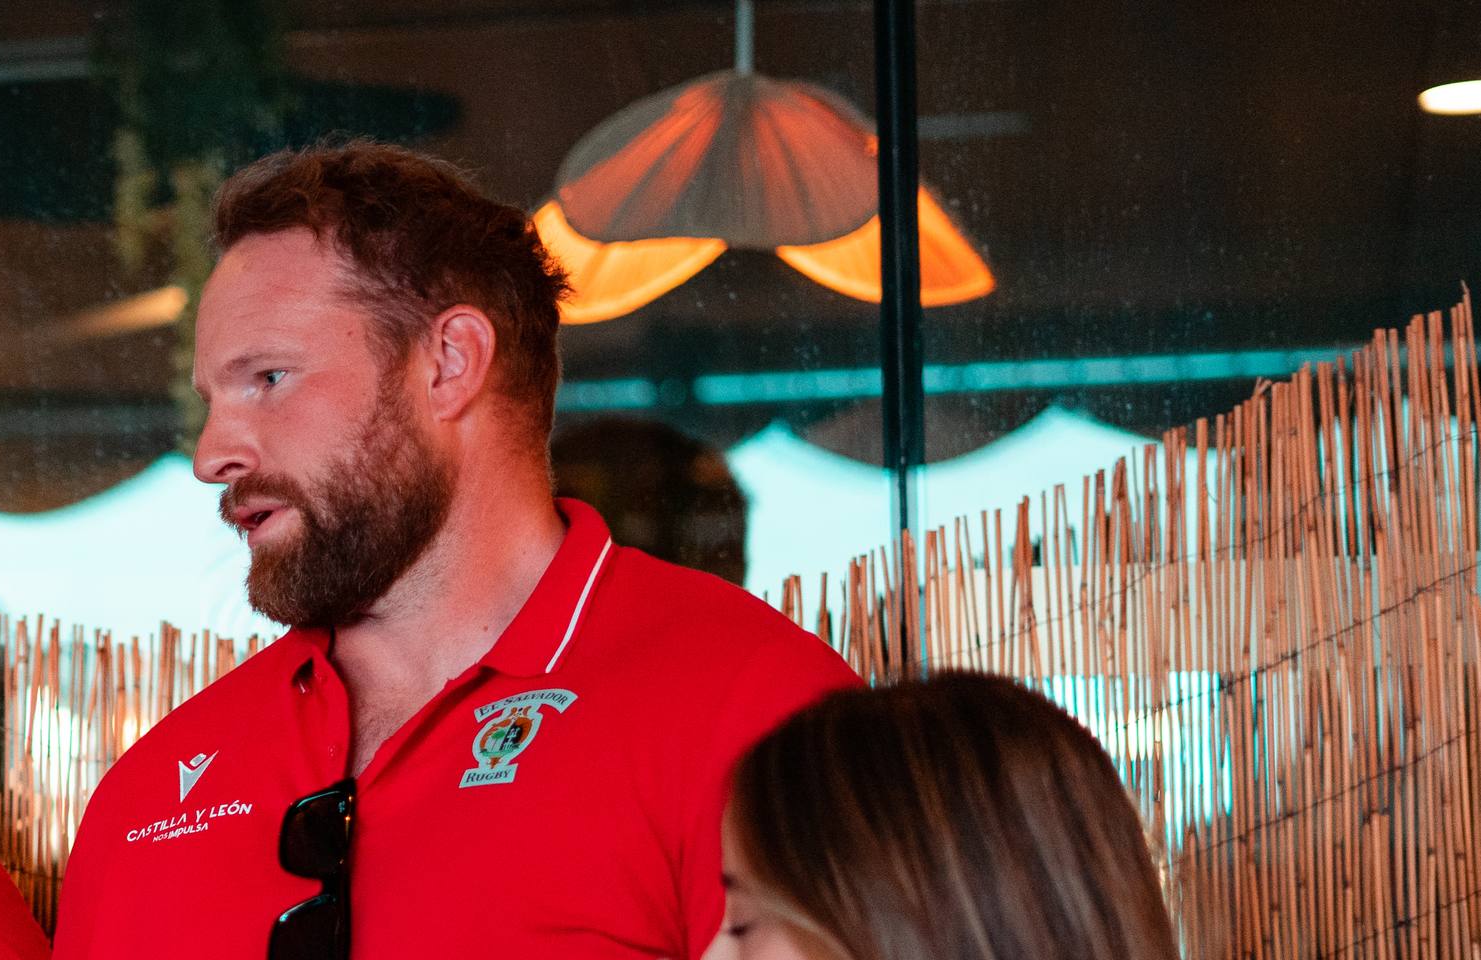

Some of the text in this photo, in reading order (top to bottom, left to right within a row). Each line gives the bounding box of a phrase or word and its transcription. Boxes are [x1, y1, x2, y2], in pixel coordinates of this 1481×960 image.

[480, 692, 568, 717] EL SALVADOR
[465, 769, 511, 783] RUGBY
[126, 800, 253, 842] CASTILLA Y LEÓN
